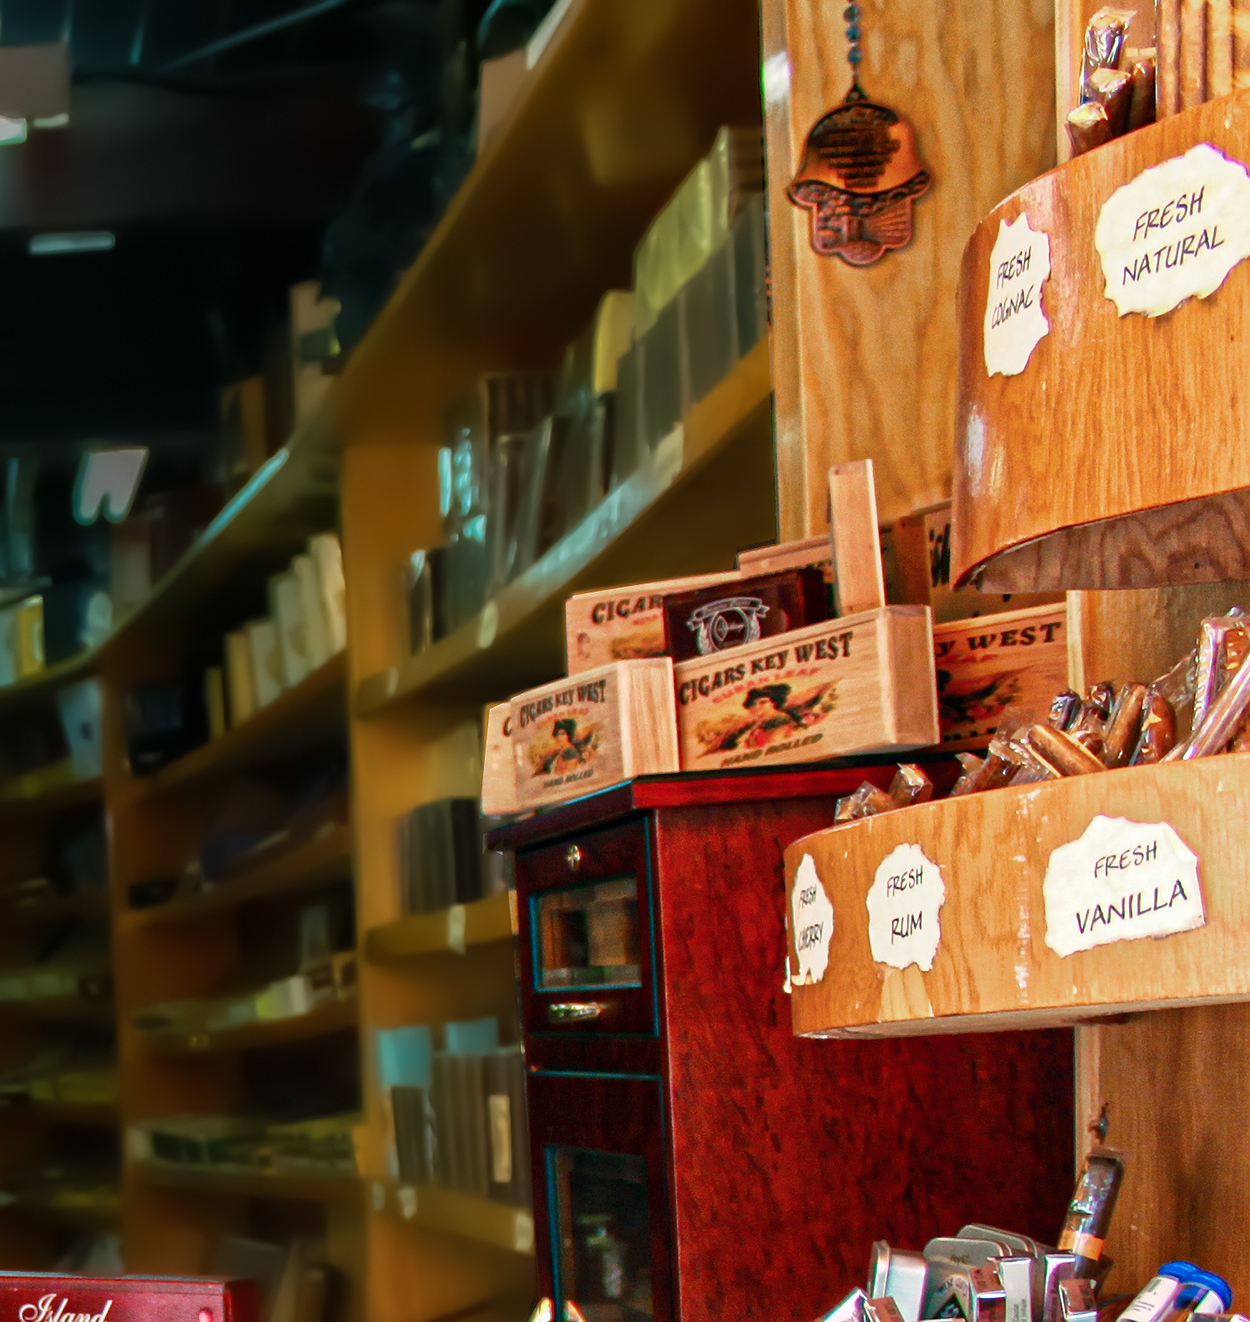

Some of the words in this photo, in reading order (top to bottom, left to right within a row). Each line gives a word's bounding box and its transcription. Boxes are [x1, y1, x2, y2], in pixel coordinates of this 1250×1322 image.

[1133, 186, 1205, 243] FRESH
[996, 246, 1032, 289] FRESH
[1122, 225, 1225, 286] NATURAL
[991, 285, 1035, 329] COGNAC
[968, 621, 1063, 651] WEST
[680, 661, 745, 705] CIGARS
[750, 649, 788, 677] KEY
[794, 631, 853, 663] WEST
[519, 694, 554, 728] CIGARS
[555, 689, 574, 709] KEY
[577, 679, 607, 704] WEST
[886, 865, 924, 897] FRESH
[1094, 841, 1159, 880] FRESH
[890, 910, 923, 945] RUM
[1075, 879, 1189, 934] VANILLA
